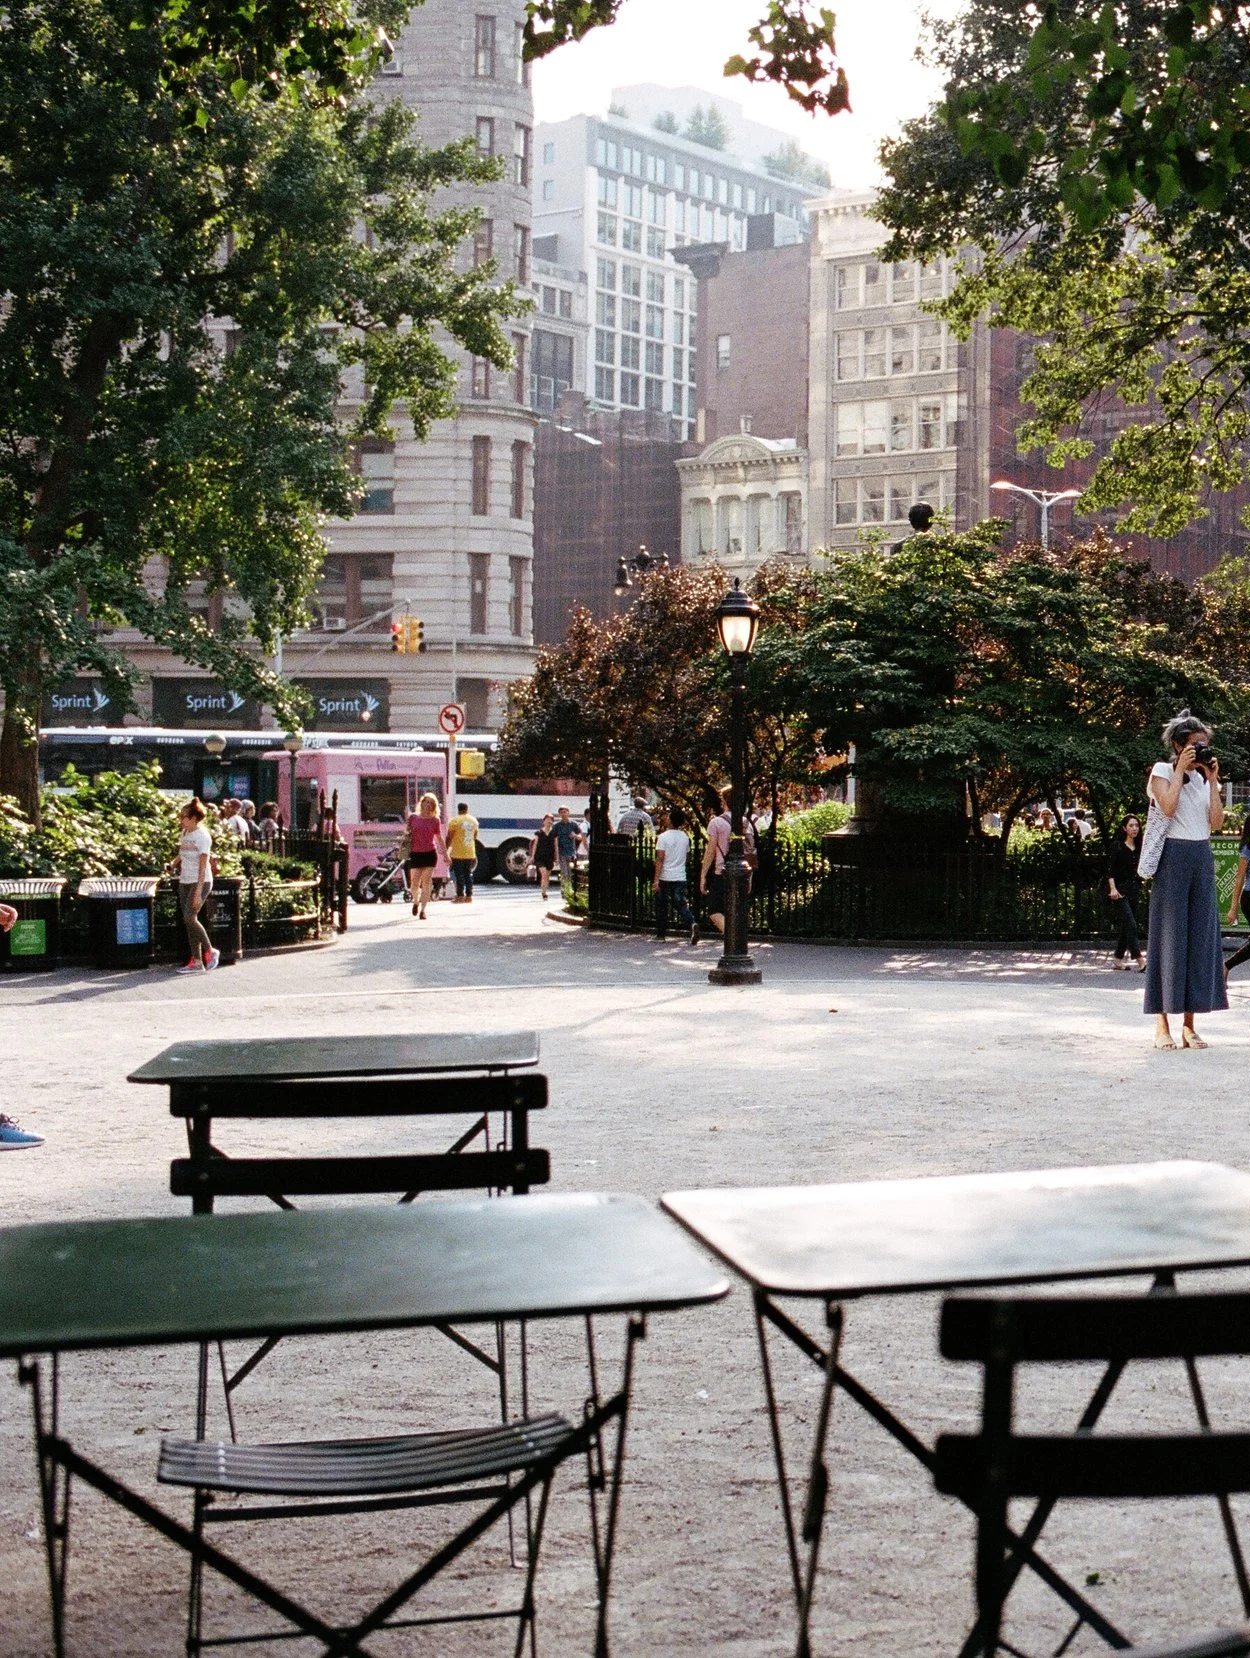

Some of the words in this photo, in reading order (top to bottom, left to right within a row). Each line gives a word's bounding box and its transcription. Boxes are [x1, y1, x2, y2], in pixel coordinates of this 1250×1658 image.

[52, 695, 92, 711] Sprint
[186, 695, 226, 711] Sprint
[319, 698, 361, 714] Sprint
